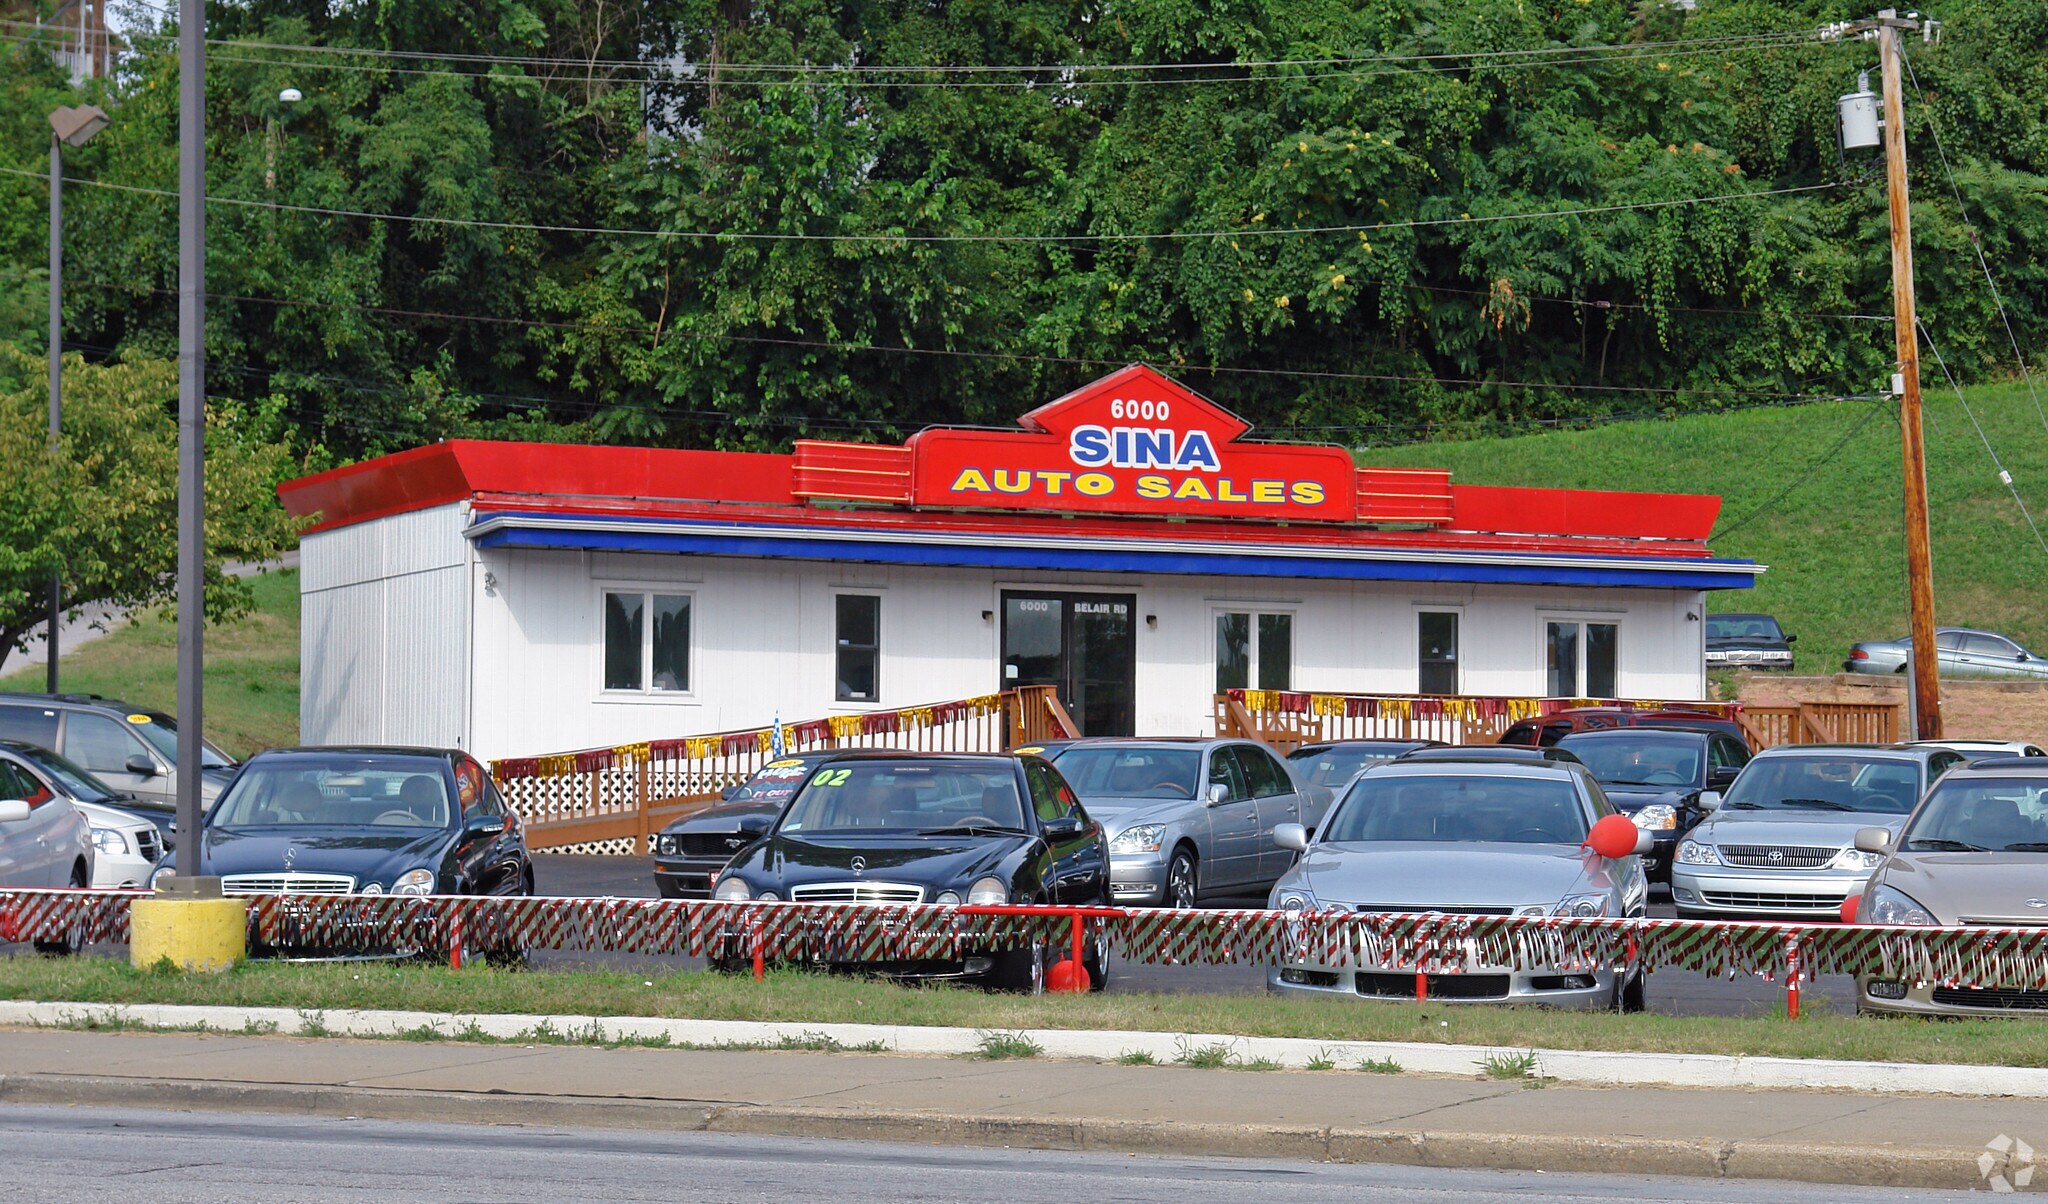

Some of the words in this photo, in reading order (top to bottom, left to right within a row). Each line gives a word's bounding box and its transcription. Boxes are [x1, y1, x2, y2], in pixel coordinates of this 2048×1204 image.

[1111, 399, 1170, 421] 6000
[1069, 424, 1221, 472] SINA
[950, 466, 1116, 497] AUTO
[1135, 473, 1326, 506] SALES
[1019, 601, 1048, 612] 6000
[1074, 602, 1110, 614] BELAIR
[1113, 604, 1128, 614] RD
[812, 768, 853, 787] 02
[766, 789, 794, 798] OUT
